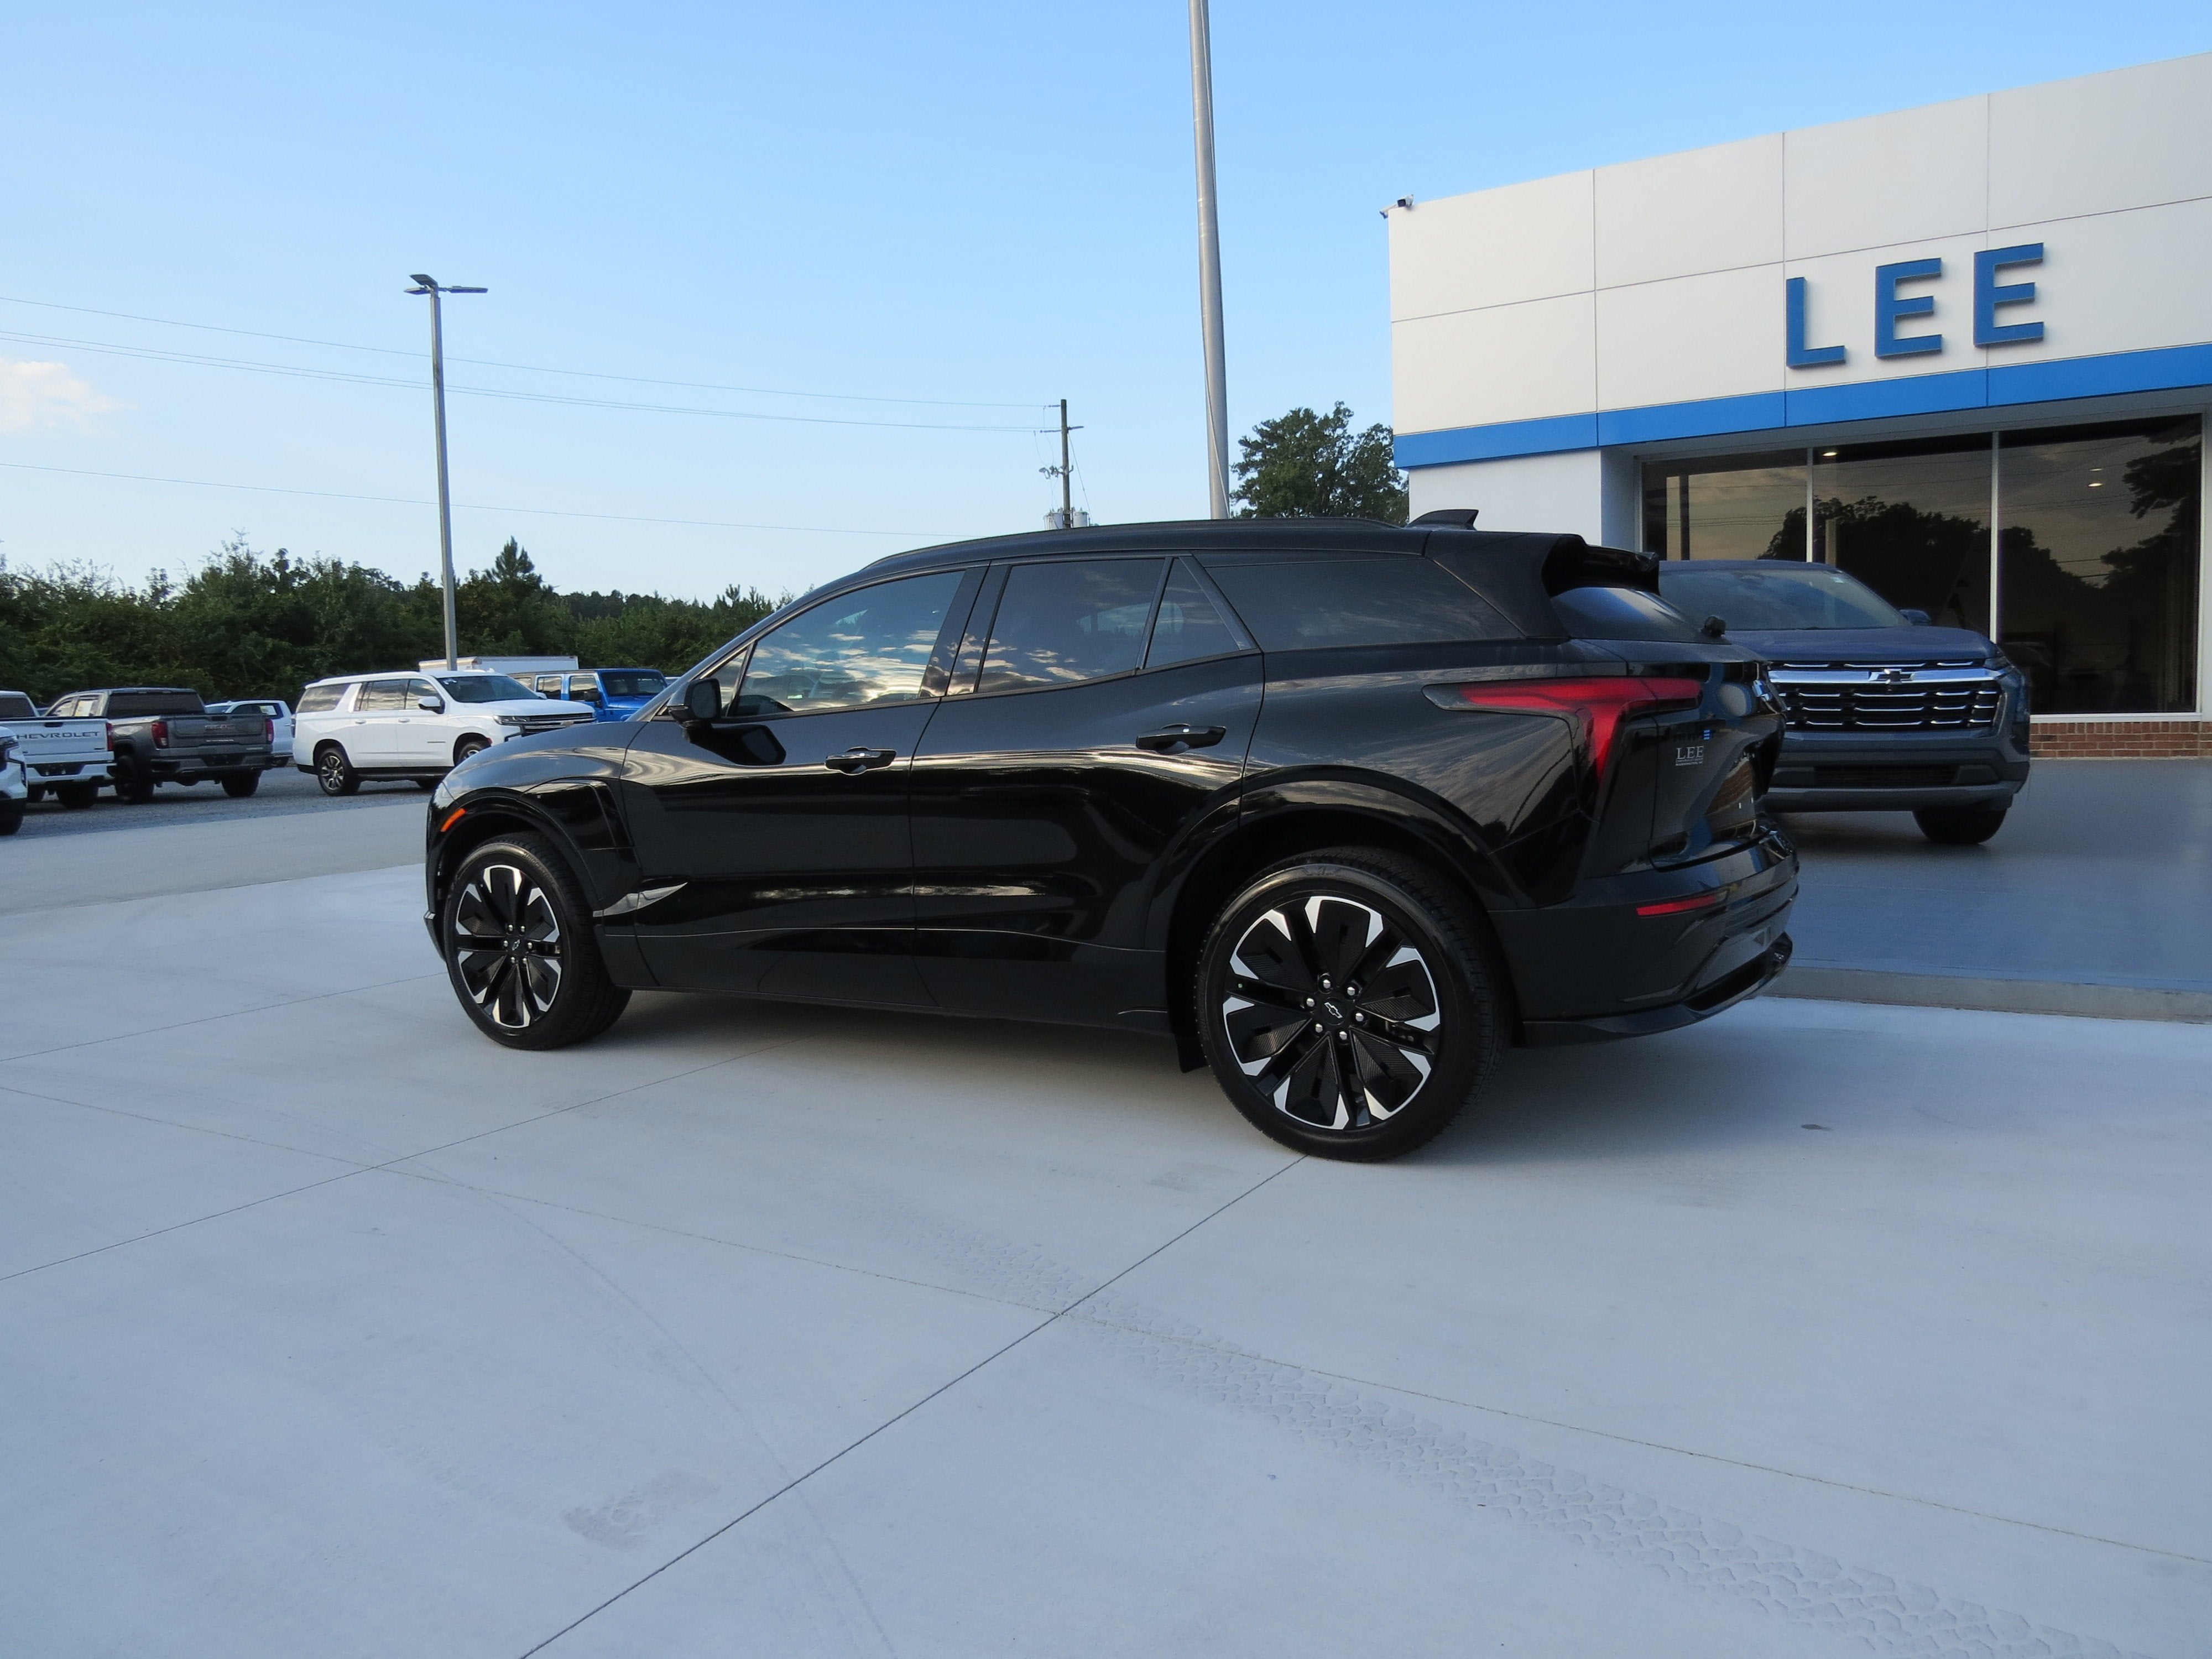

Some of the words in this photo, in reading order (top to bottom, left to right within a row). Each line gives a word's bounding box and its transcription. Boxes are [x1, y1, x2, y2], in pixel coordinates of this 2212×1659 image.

[1785, 242, 2044, 368] LEE
[16, 731, 101, 739] HEVROLET
[1676, 745, 1704, 759] LEE
